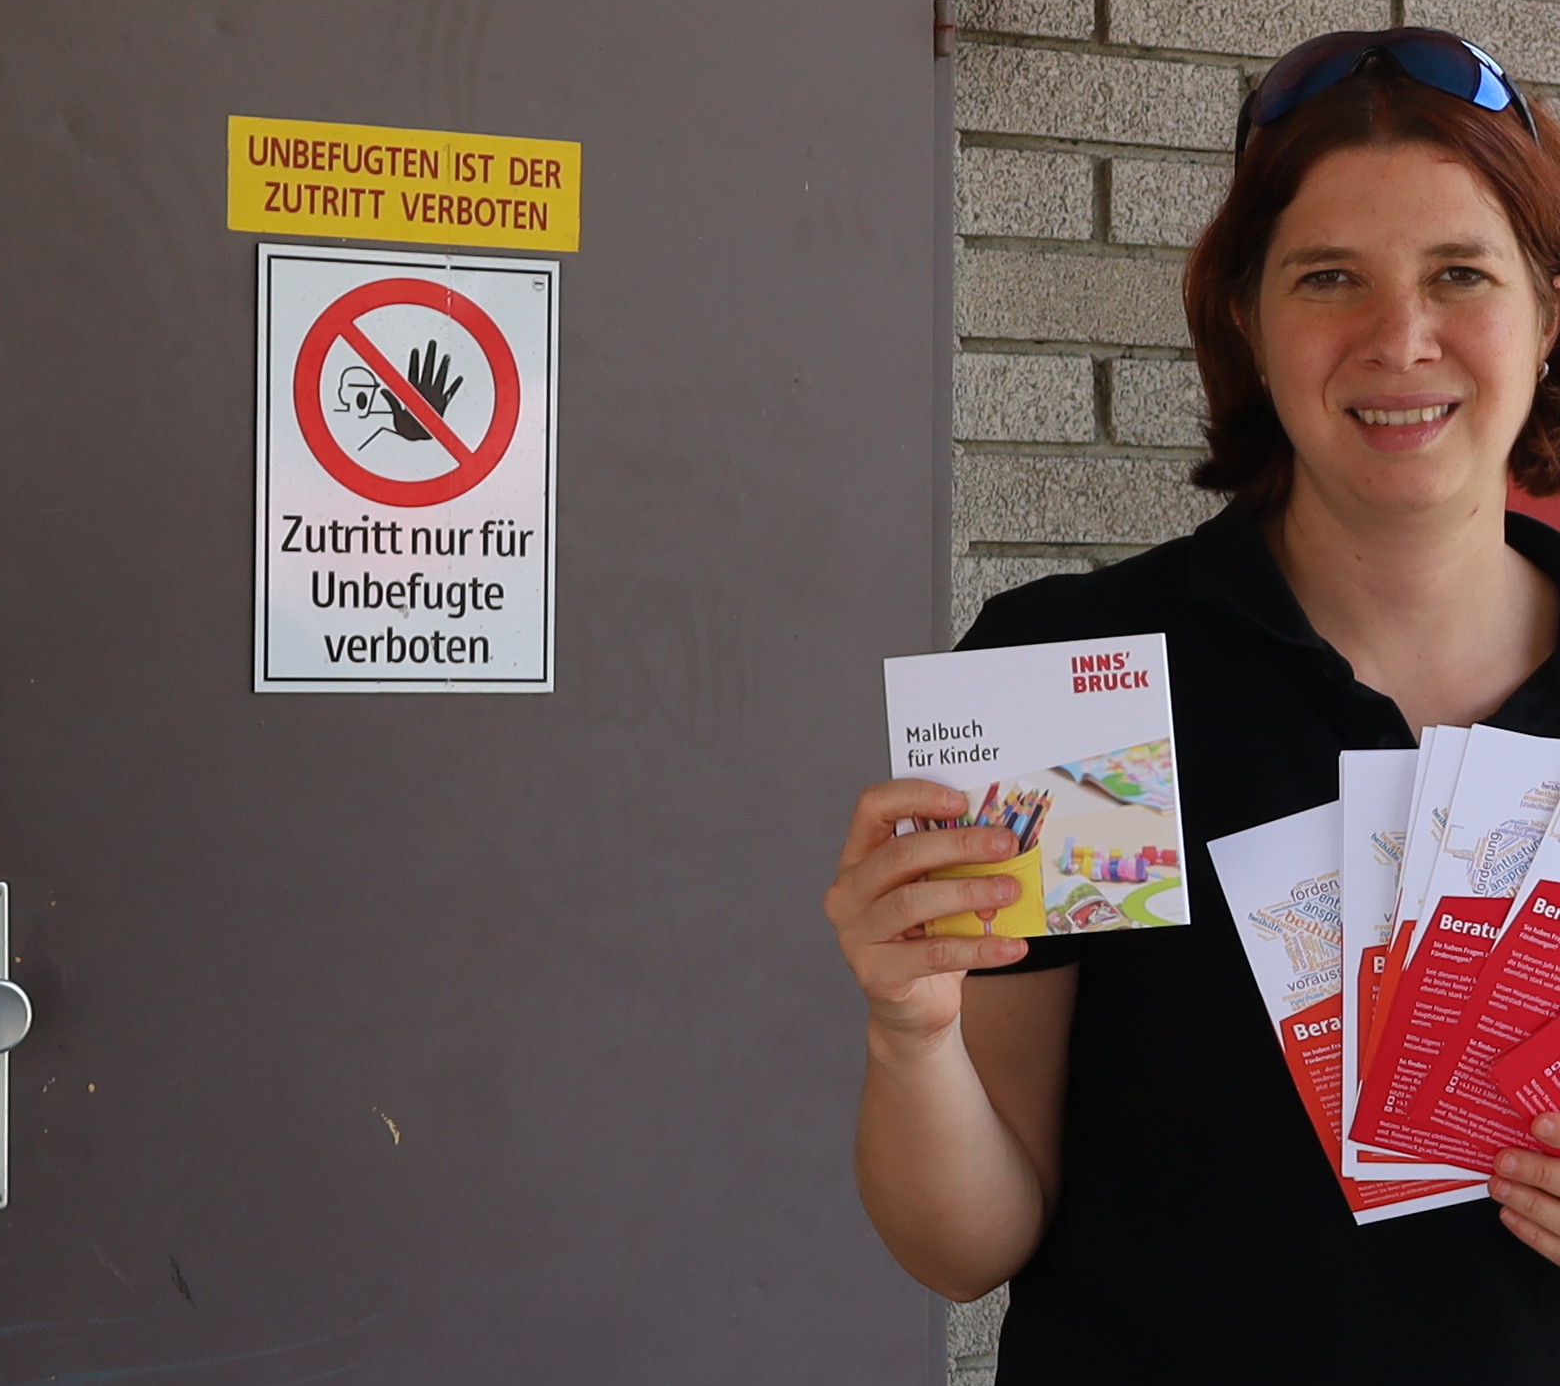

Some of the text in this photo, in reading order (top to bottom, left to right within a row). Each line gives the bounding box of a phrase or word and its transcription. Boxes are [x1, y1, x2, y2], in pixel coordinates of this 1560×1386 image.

[249, 135, 561, 188] UNBEFUGTEN IST DER
[265, 181, 548, 231] ZUTRITT VERBOTEN
[281, 515, 534, 557] Zutritt nur für
[312, 570, 504, 618] Unbefugte
[324, 626, 489, 664] verboten
[1071, 652, 1130, 673] INNS'
[1073, 670, 1150, 693] BRUCK
[906, 719, 983, 744] Malbuch
[908, 744, 1000, 767] für Kinder
[1472, 831, 1502, 895] förderung
[1248, 912, 1283, 933] beihilfe
[1523, 923, 1532, 932] Sie
[1533, 926, 1550, 937] haben
[1433, 941, 1484, 957] Sie haben Fragen
[1519, 932, 1559, 951] Förderungen?
[1431, 951, 1473, 964] Förderungen?
[1517, 961, 1534, 974] bisher
[1535, 967, 1549, 977] keine
[1521, 953, 1541, 964] diesem
[1542, 959, 1555, 970] Jahr
[1503, 966, 1543, 987] ebenfalls stark
[1492, 990, 1550, 1017] hauptstadt Innsbruck
[1496, 983, 1512, 994] Unser
[1513, 987, 1551, 1007] Hauptanliegen
[1293, 1015, 1341, 1041] Bera
[1480, 1014, 1512, 1031] Bitte zögern
[1478, 1040, 1496, 1053] finden
[1453, 1069, 1468, 1080] 6020
[1438, 1099, 1458, 1112] Nutzen
[1468, 1110, 1486, 1122] unsere
